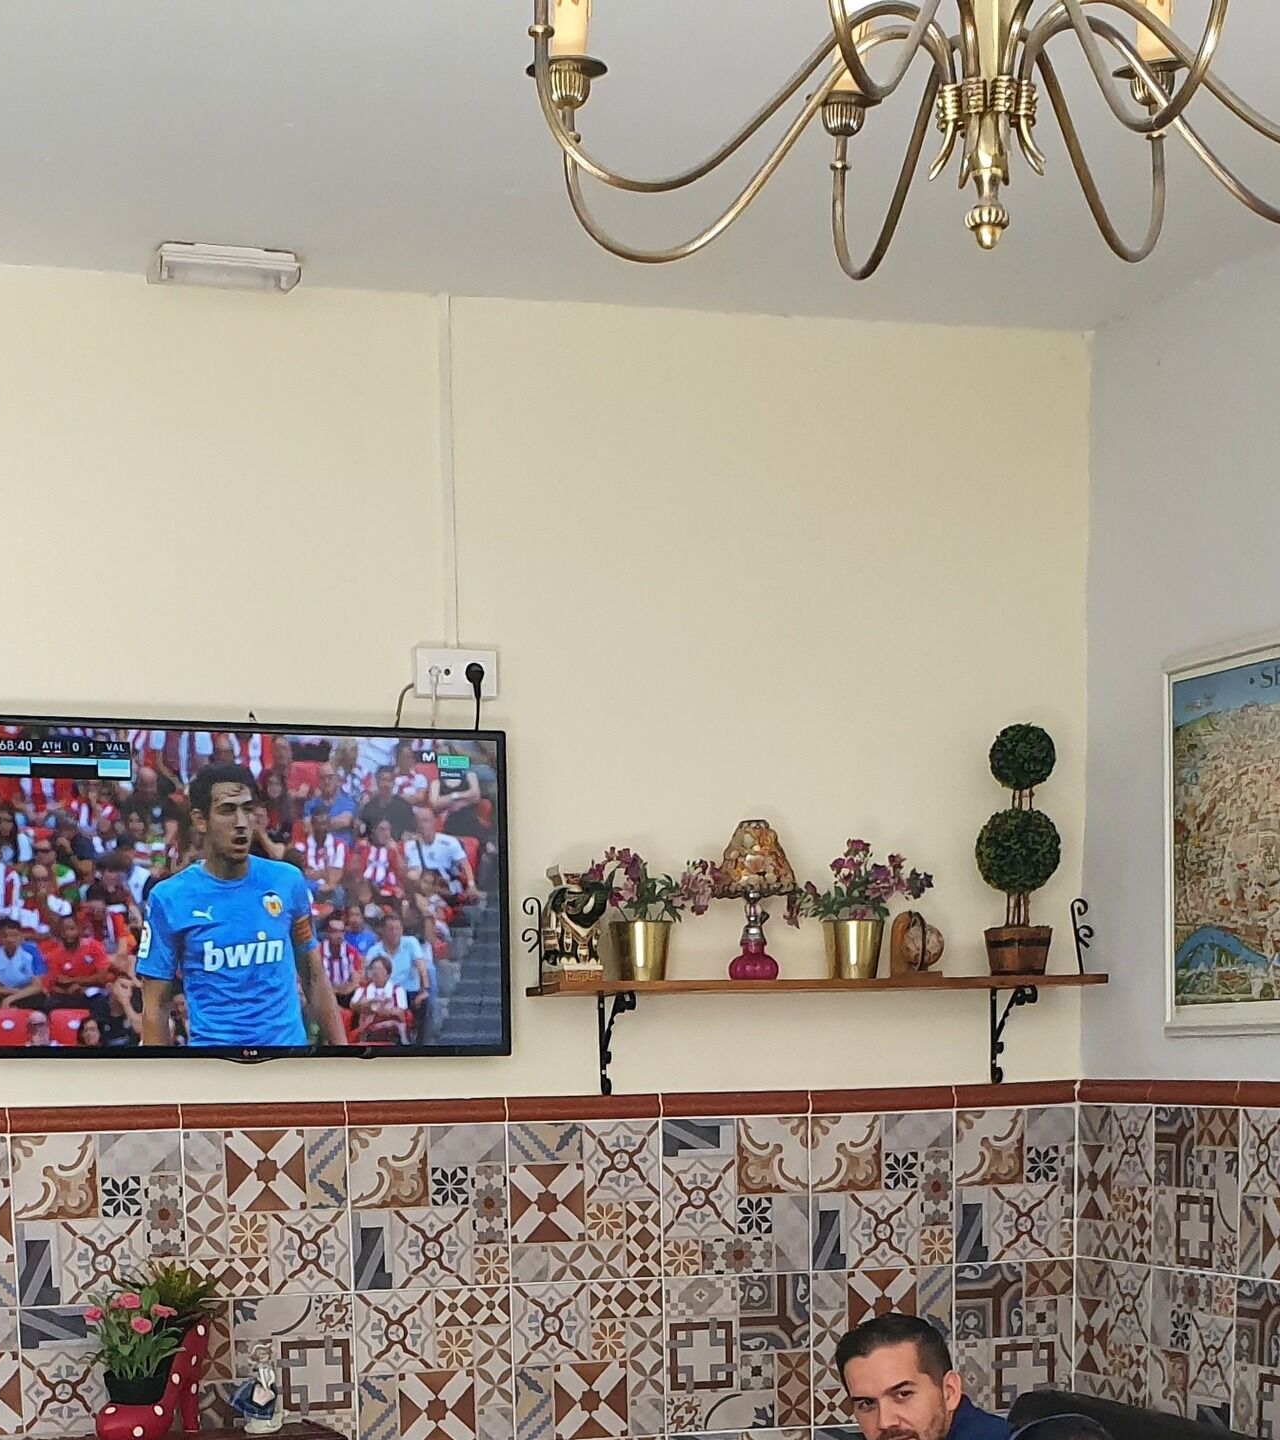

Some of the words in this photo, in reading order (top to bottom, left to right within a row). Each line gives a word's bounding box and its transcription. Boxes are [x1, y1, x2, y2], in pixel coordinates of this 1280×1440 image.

[41, 741, 62, 750] ATH
[72, 742, 80, 752] 0
[88, 742, 94, 752] 1
[105, 742, 125, 752] VAL
[202, 930, 284, 972] bwin
